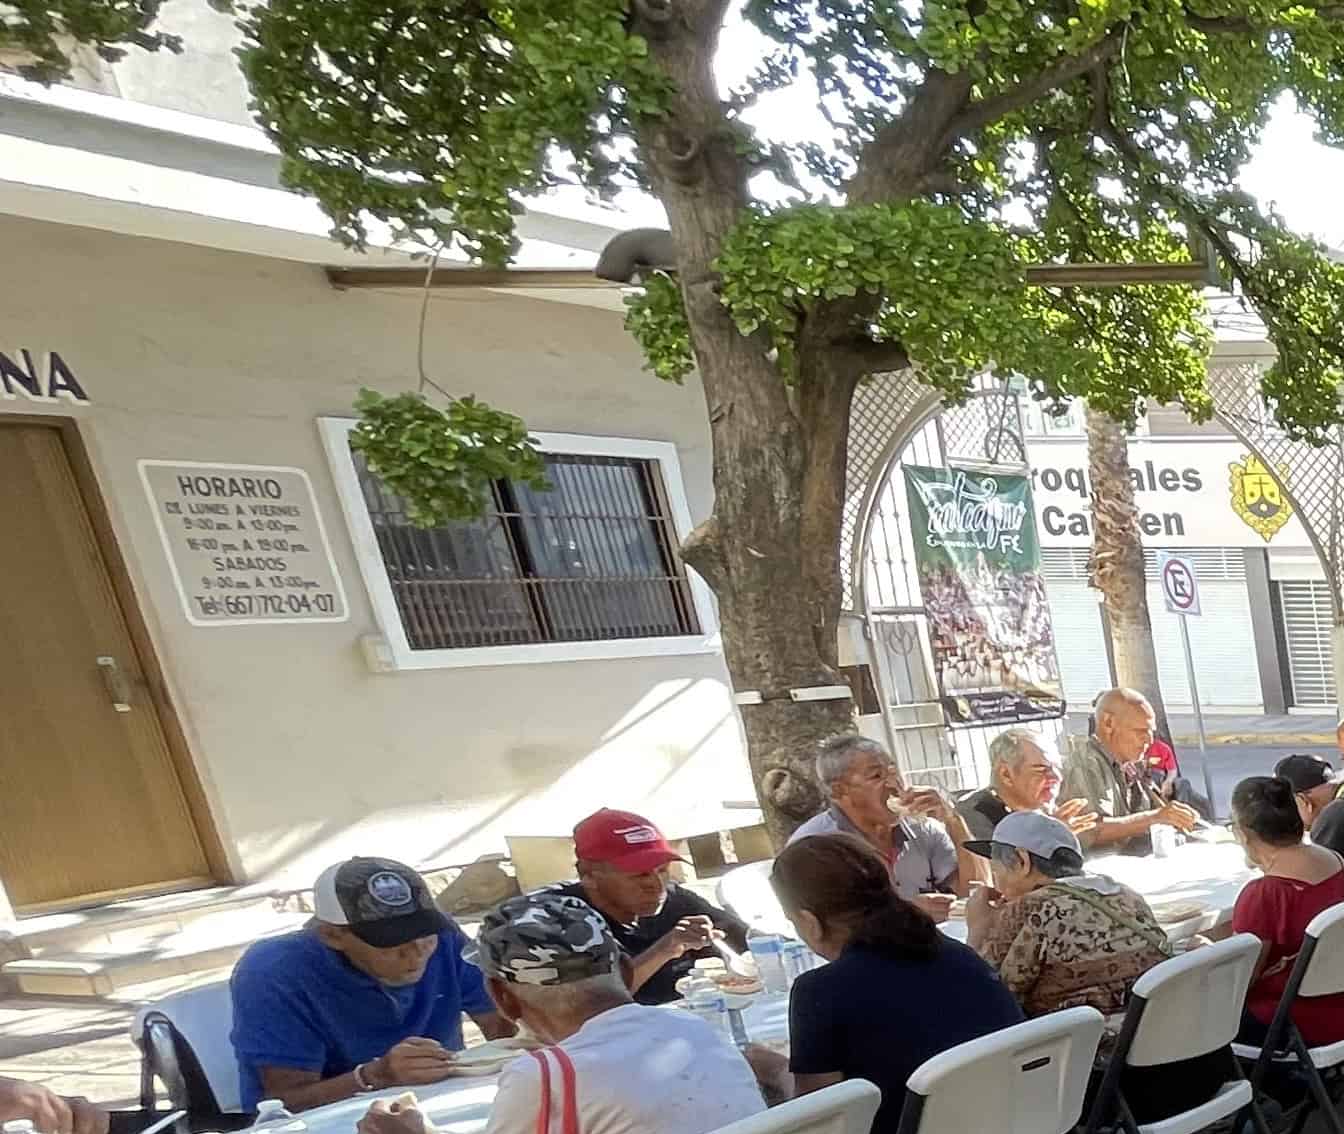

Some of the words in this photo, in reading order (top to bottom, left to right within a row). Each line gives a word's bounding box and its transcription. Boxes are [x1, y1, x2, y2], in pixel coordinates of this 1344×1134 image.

[1031, 460, 1202, 498] roqales
[177, 475, 282, 499] HORARIO
[189, 504, 229, 516] LUNES
[236, 504, 246, 516] A
[250, 505, 300, 517] VIERNES
[237, 519, 246, 530] A
[1042, 505, 1185, 536] Caen
[243, 539, 254, 551] A
[212, 557, 287, 571] SABADOS
[255, 576, 265, 588] A
